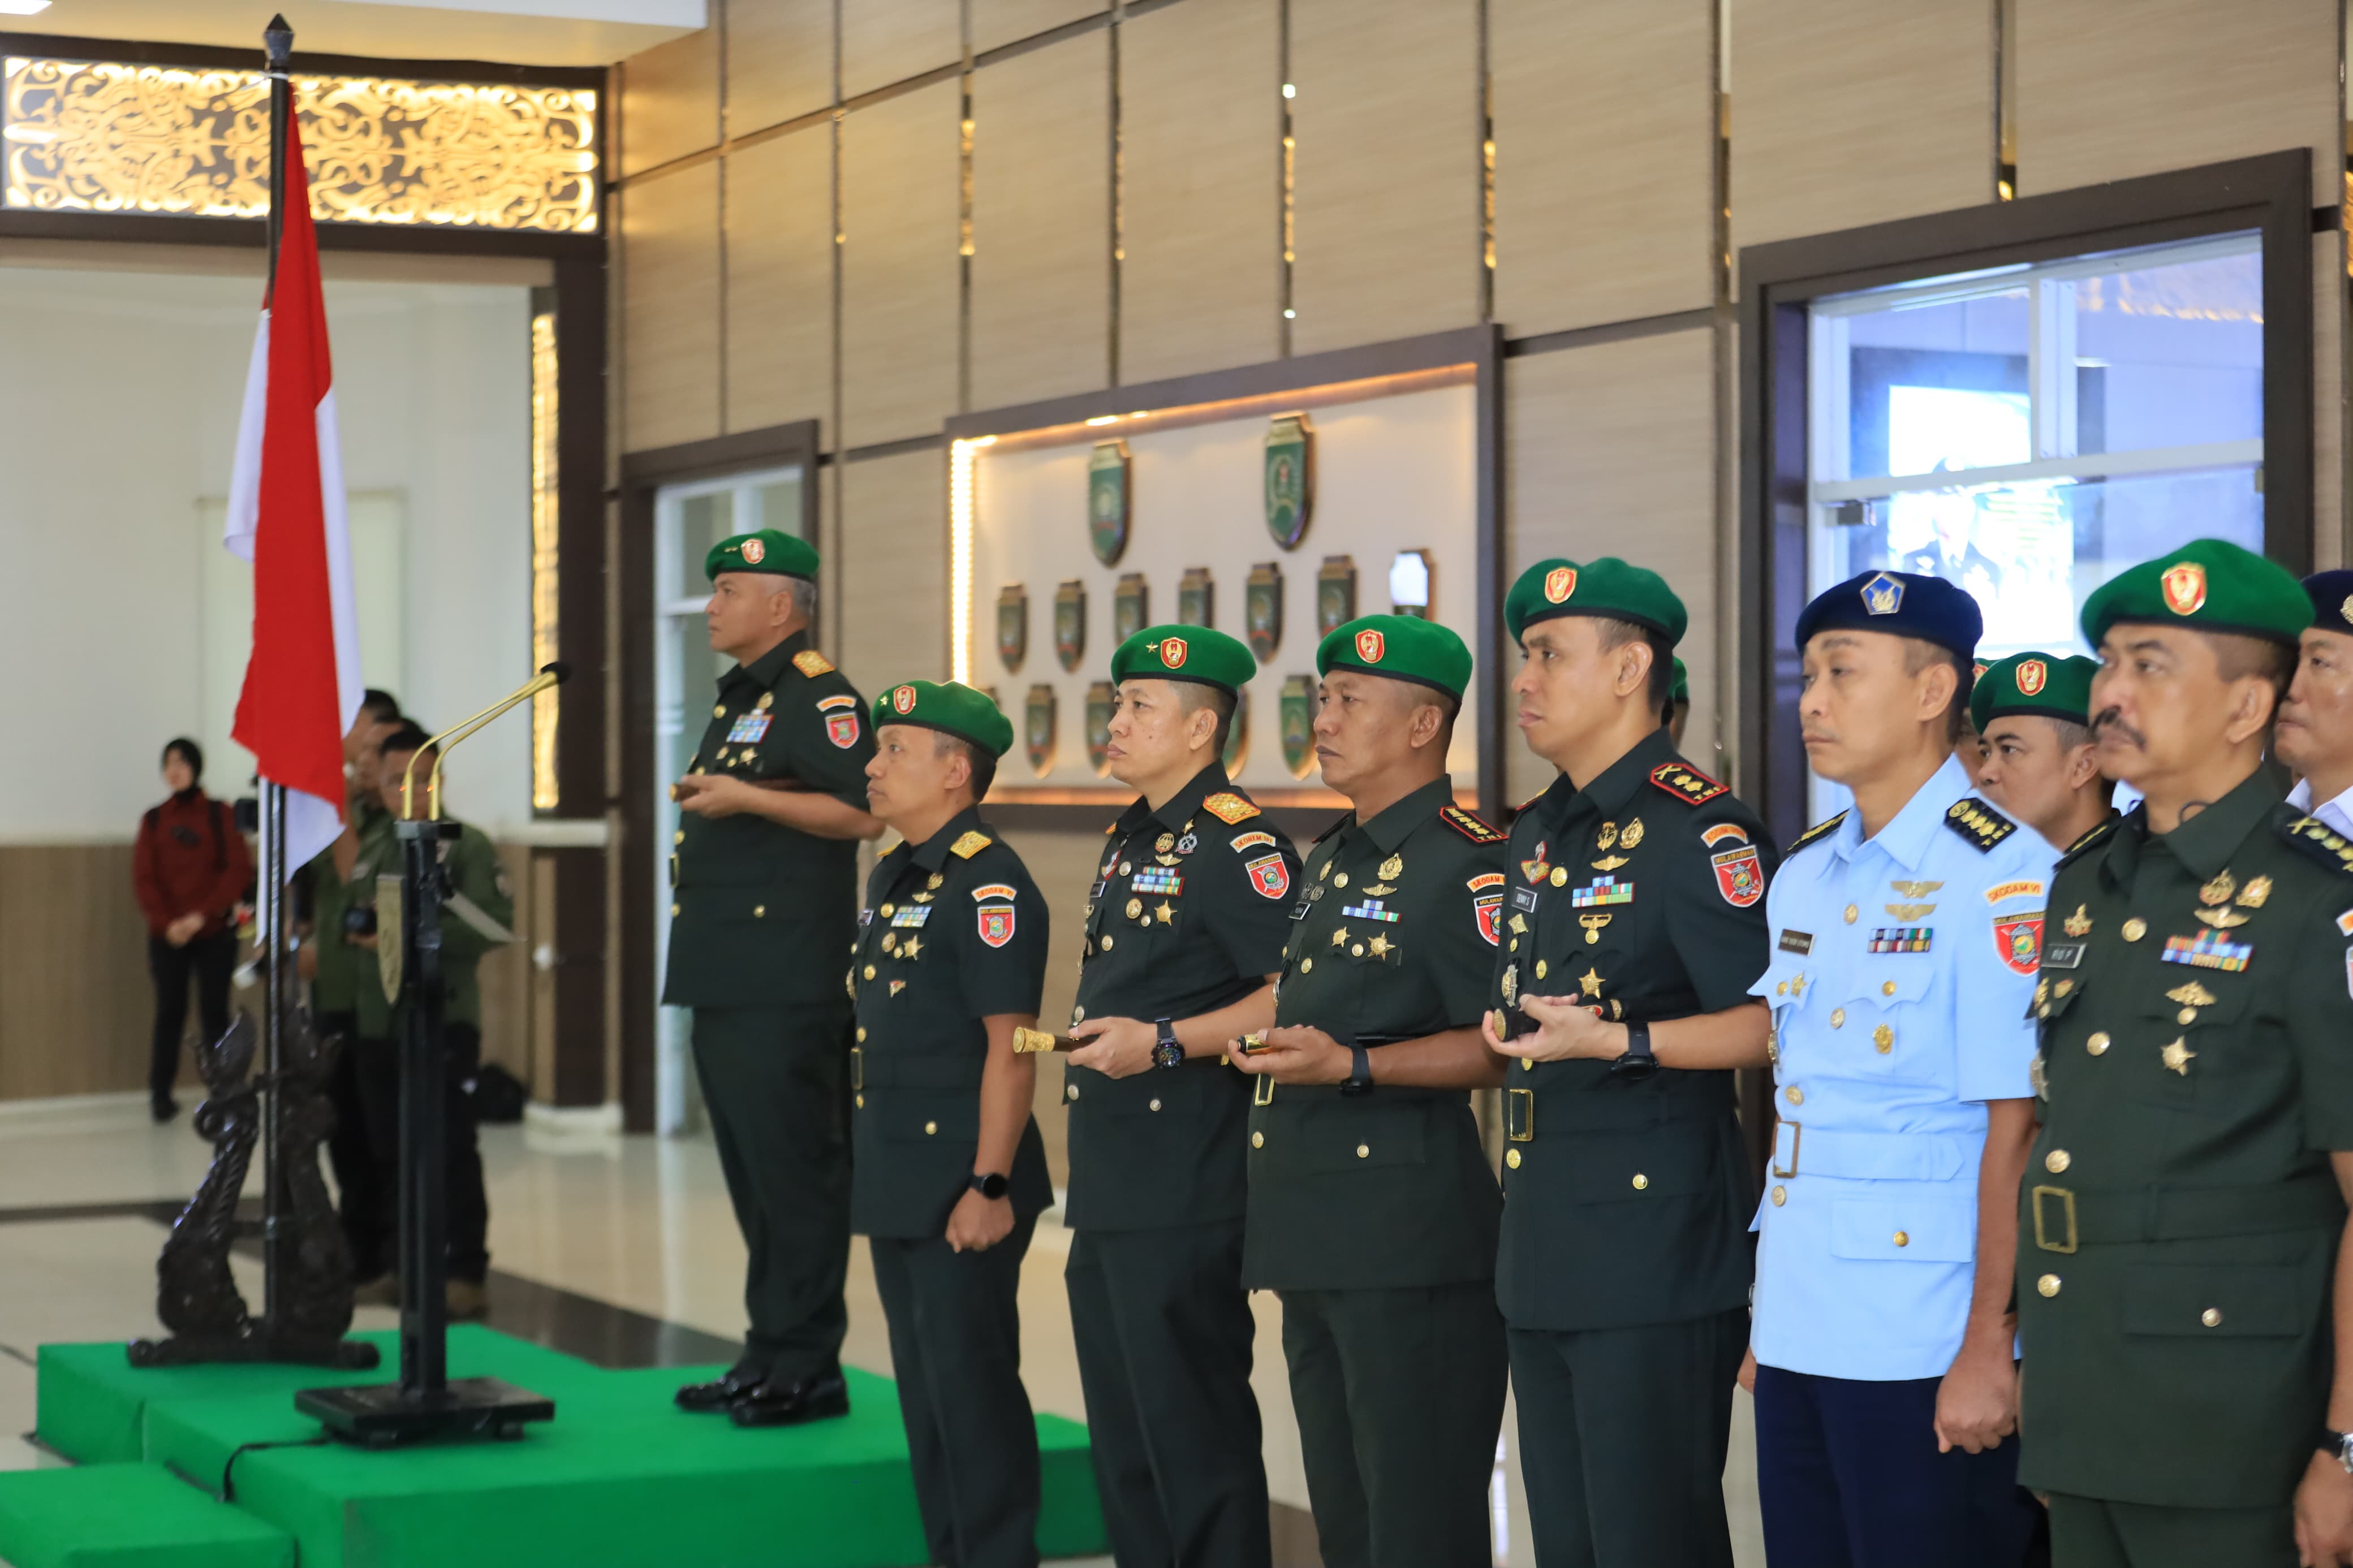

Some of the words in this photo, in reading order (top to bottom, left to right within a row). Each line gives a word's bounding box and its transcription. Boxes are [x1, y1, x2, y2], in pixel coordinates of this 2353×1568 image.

[1235, 835, 1261, 848] SKOREM
[1248, 856, 1280, 869] MULAWARMAN
[1715, 848, 1755, 865] MULAWARMAN
[1987, 883, 2028, 902] SKODAM
[1479, 897, 1503, 905] MULAWAR
